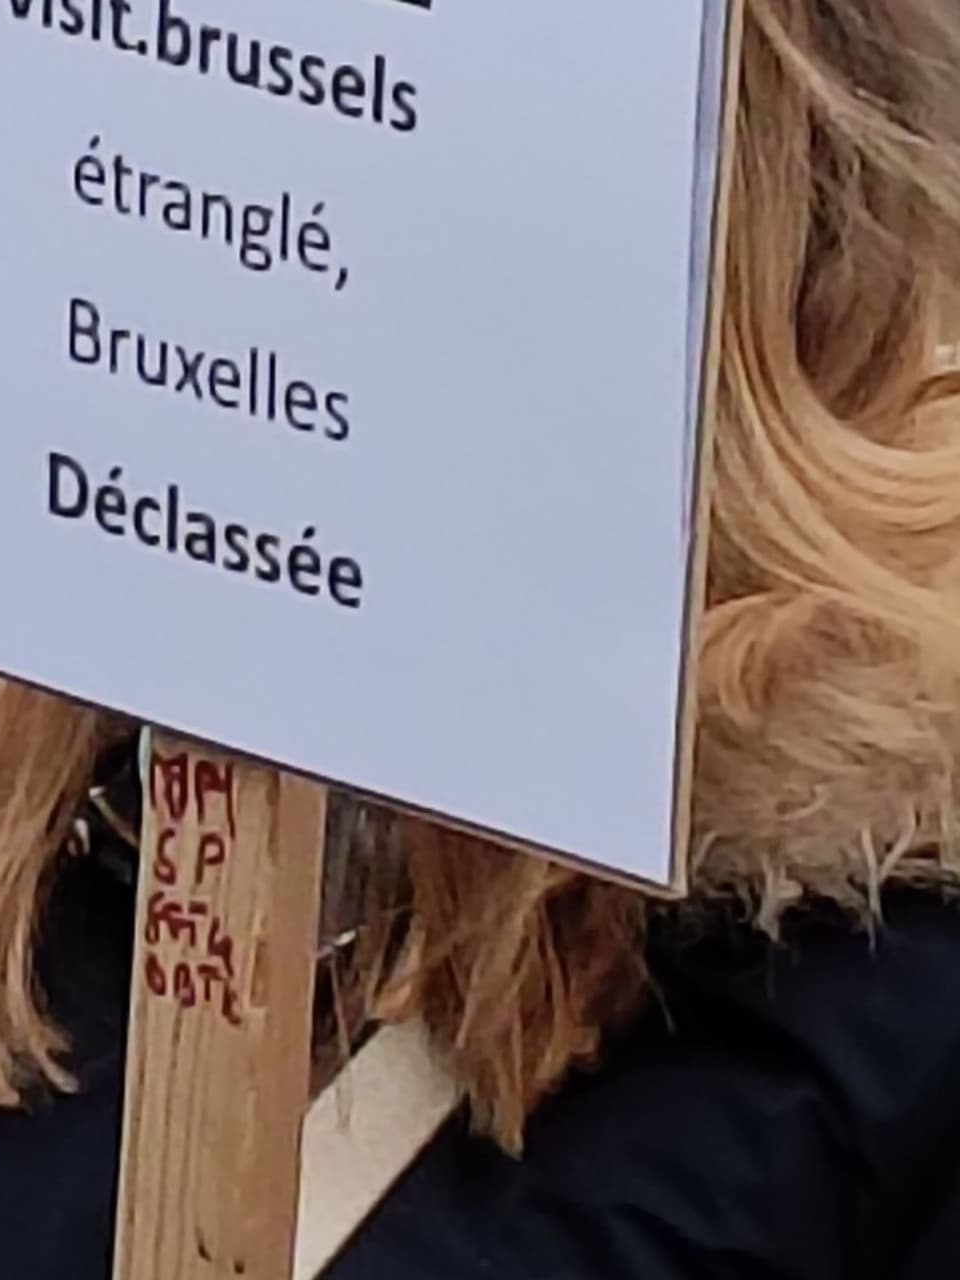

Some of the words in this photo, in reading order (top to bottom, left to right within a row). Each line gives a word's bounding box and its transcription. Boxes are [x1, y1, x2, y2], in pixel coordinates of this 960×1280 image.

[73, 134, 350, 292] étranglé,
[67, 297, 351, 442] Bruxelles
[47, 451, 364, 609] Déclassée
